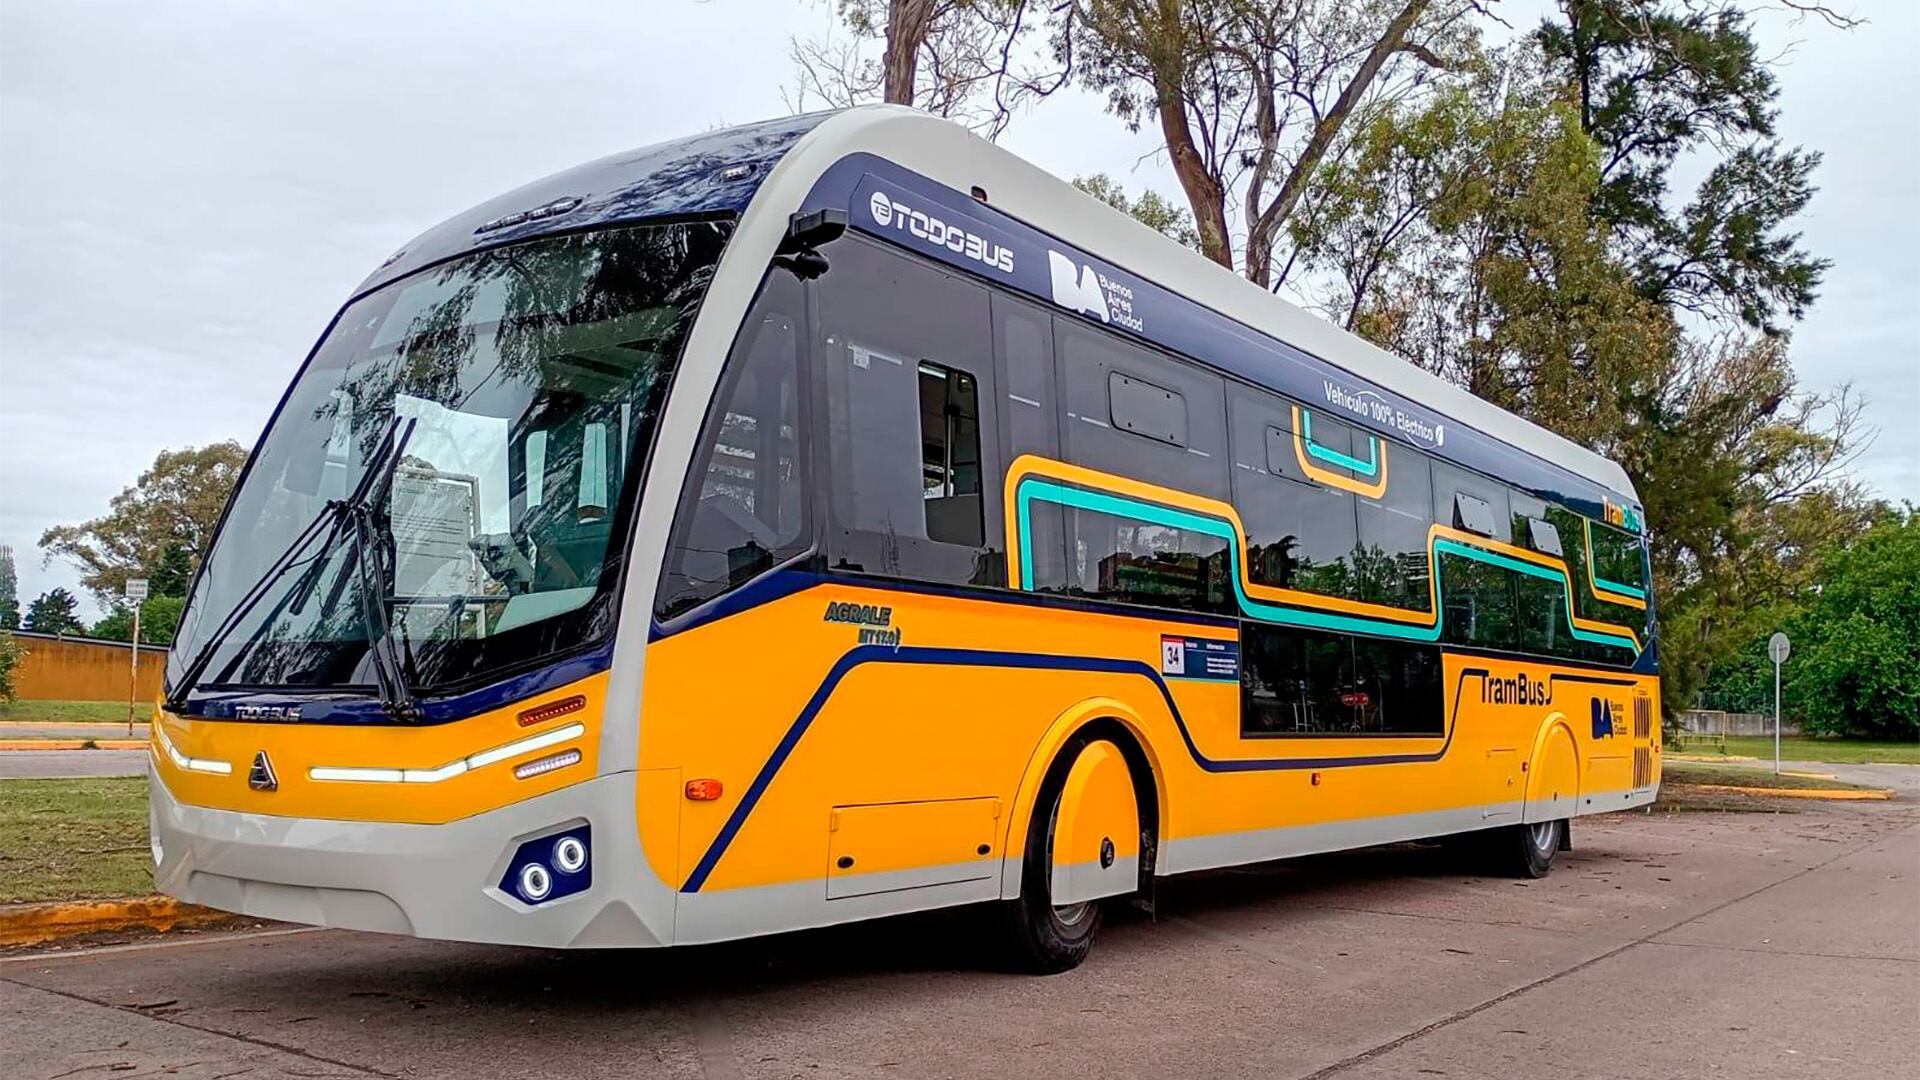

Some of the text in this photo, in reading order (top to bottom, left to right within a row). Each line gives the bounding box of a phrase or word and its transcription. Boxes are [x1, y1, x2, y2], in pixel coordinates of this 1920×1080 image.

[892, 202, 1014, 273] TODOBUS
[1099, 274, 1133, 300] Buenos
[1108, 291, 1132, 313] Aires
[1112, 307, 1143, 332] Ciudad
[1324, 380, 1434, 441] Vehículo 100% Eléctrico
[823, 601, 892, 626] AGRALE
[1167, 646, 1179, 666] 34
[1480, 670, 1544, 706] TramBus
